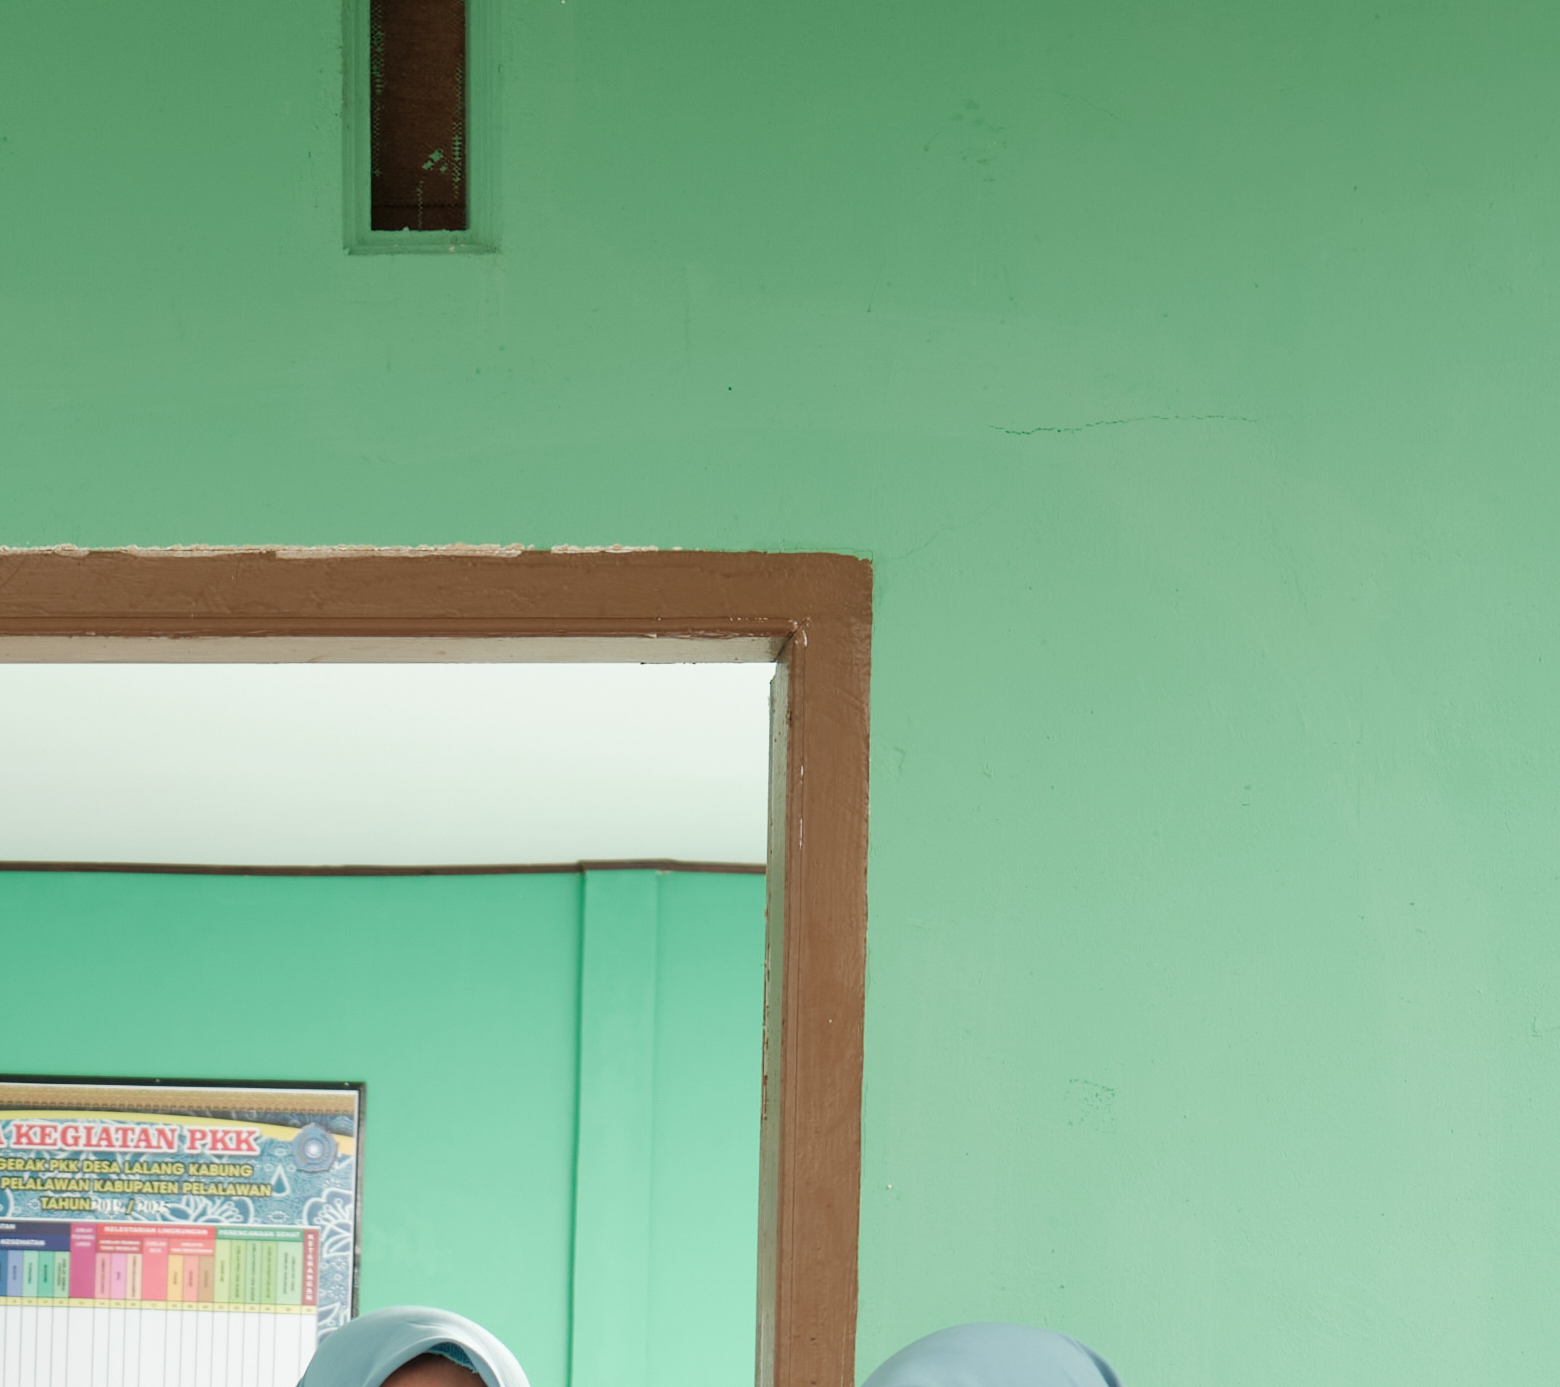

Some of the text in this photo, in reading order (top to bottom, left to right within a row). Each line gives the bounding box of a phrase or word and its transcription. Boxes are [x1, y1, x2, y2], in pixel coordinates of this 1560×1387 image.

[12, 1123, 177, 1150] KEGIATAN
[186, 1128, 259, 1153] PKK
[49, 1159, 79, 1173] PKK
[82, 1160, 121, 1174] DESA
[124, 1161, 185, 1176] LALANG
[188, 1162, 254, 1178] KABUNG
[1, 1176, 90, 1192] PELALAWAN
[92, 1179, 179, 1194] KABUPATEN
[182, 1182, 272, 1197] PELALAWAN
